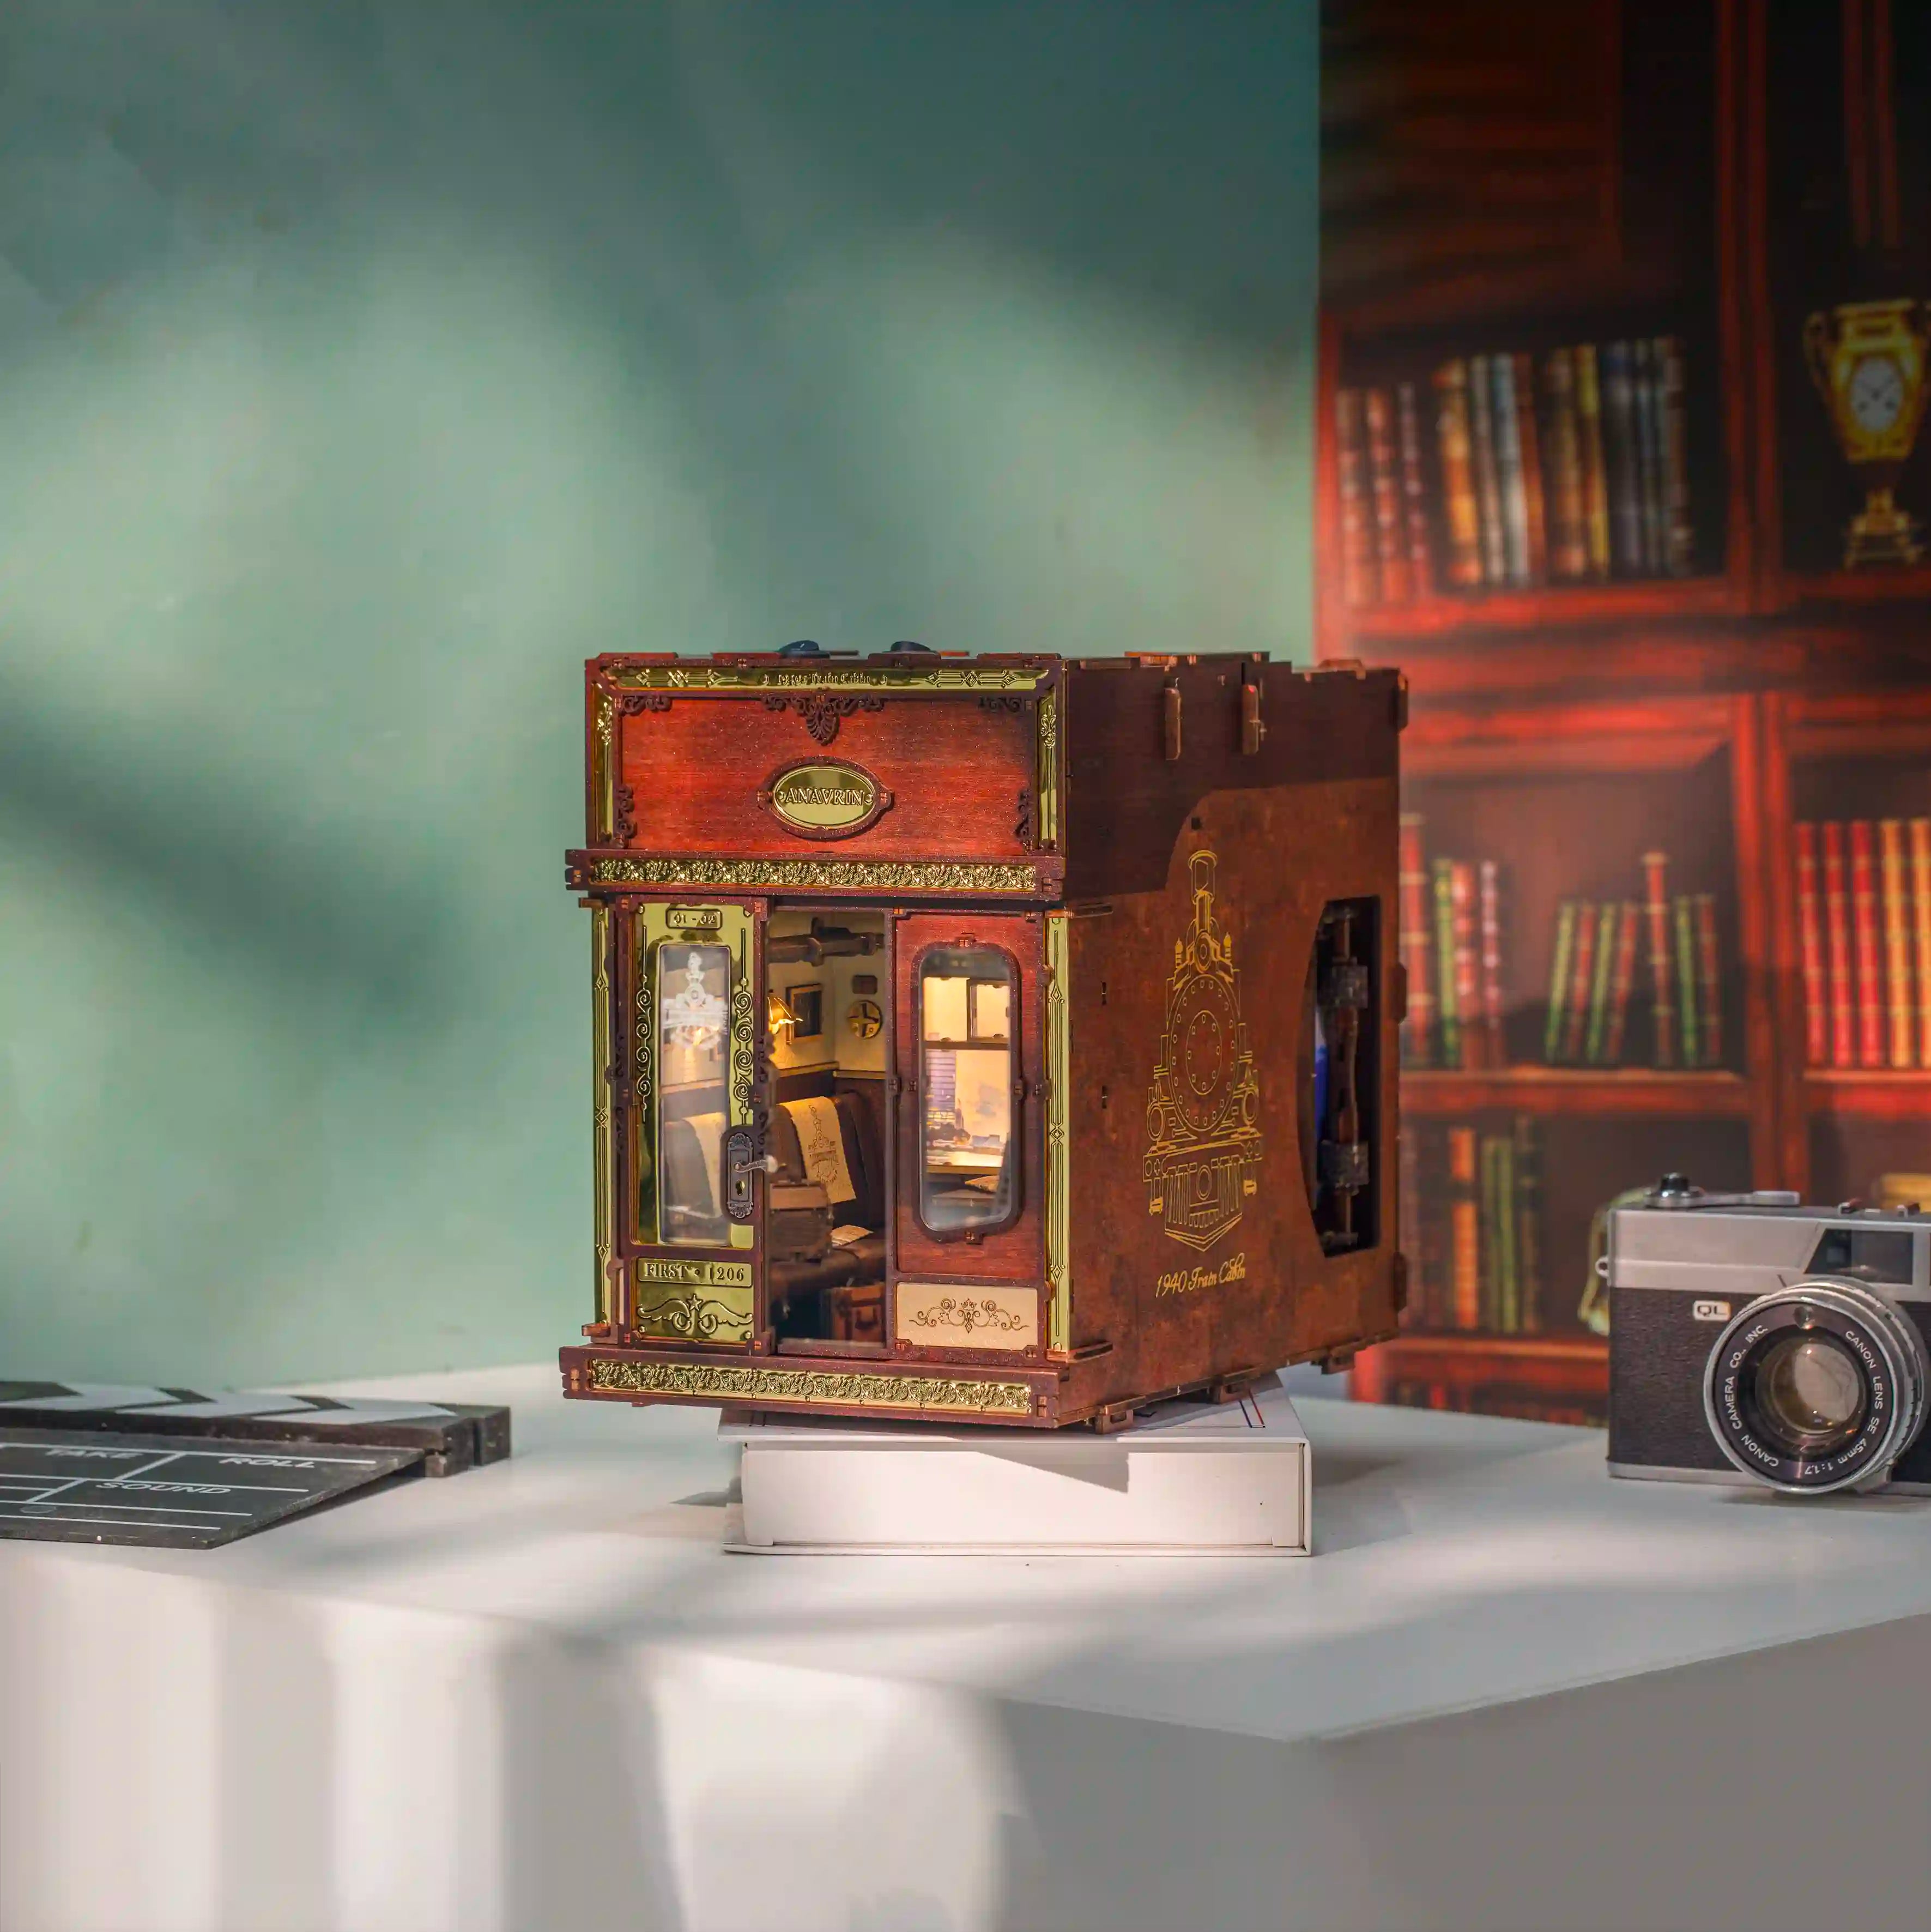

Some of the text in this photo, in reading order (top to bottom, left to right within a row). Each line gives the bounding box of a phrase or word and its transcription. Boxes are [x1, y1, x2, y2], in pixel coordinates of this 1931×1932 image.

[785, 787, 864, 806] ANAVRIN
[645, 1262, 744, 1282] FIRST 1206
[1155, 1252, 1246, 1298] 1940 Train Cabin
[1697, 1305, 1727, 1317] QL
[1724, 1375, 1743, 1429] CAMERA
[1804, 1330, 1884, 1476] CANON LENS SE 45mm 1:1.7
[1741, 1434, 1779, 1467] CANON
[219, 1457, 316, 1469] ROLL
[95, 1481, 232, 1494] SOUND
